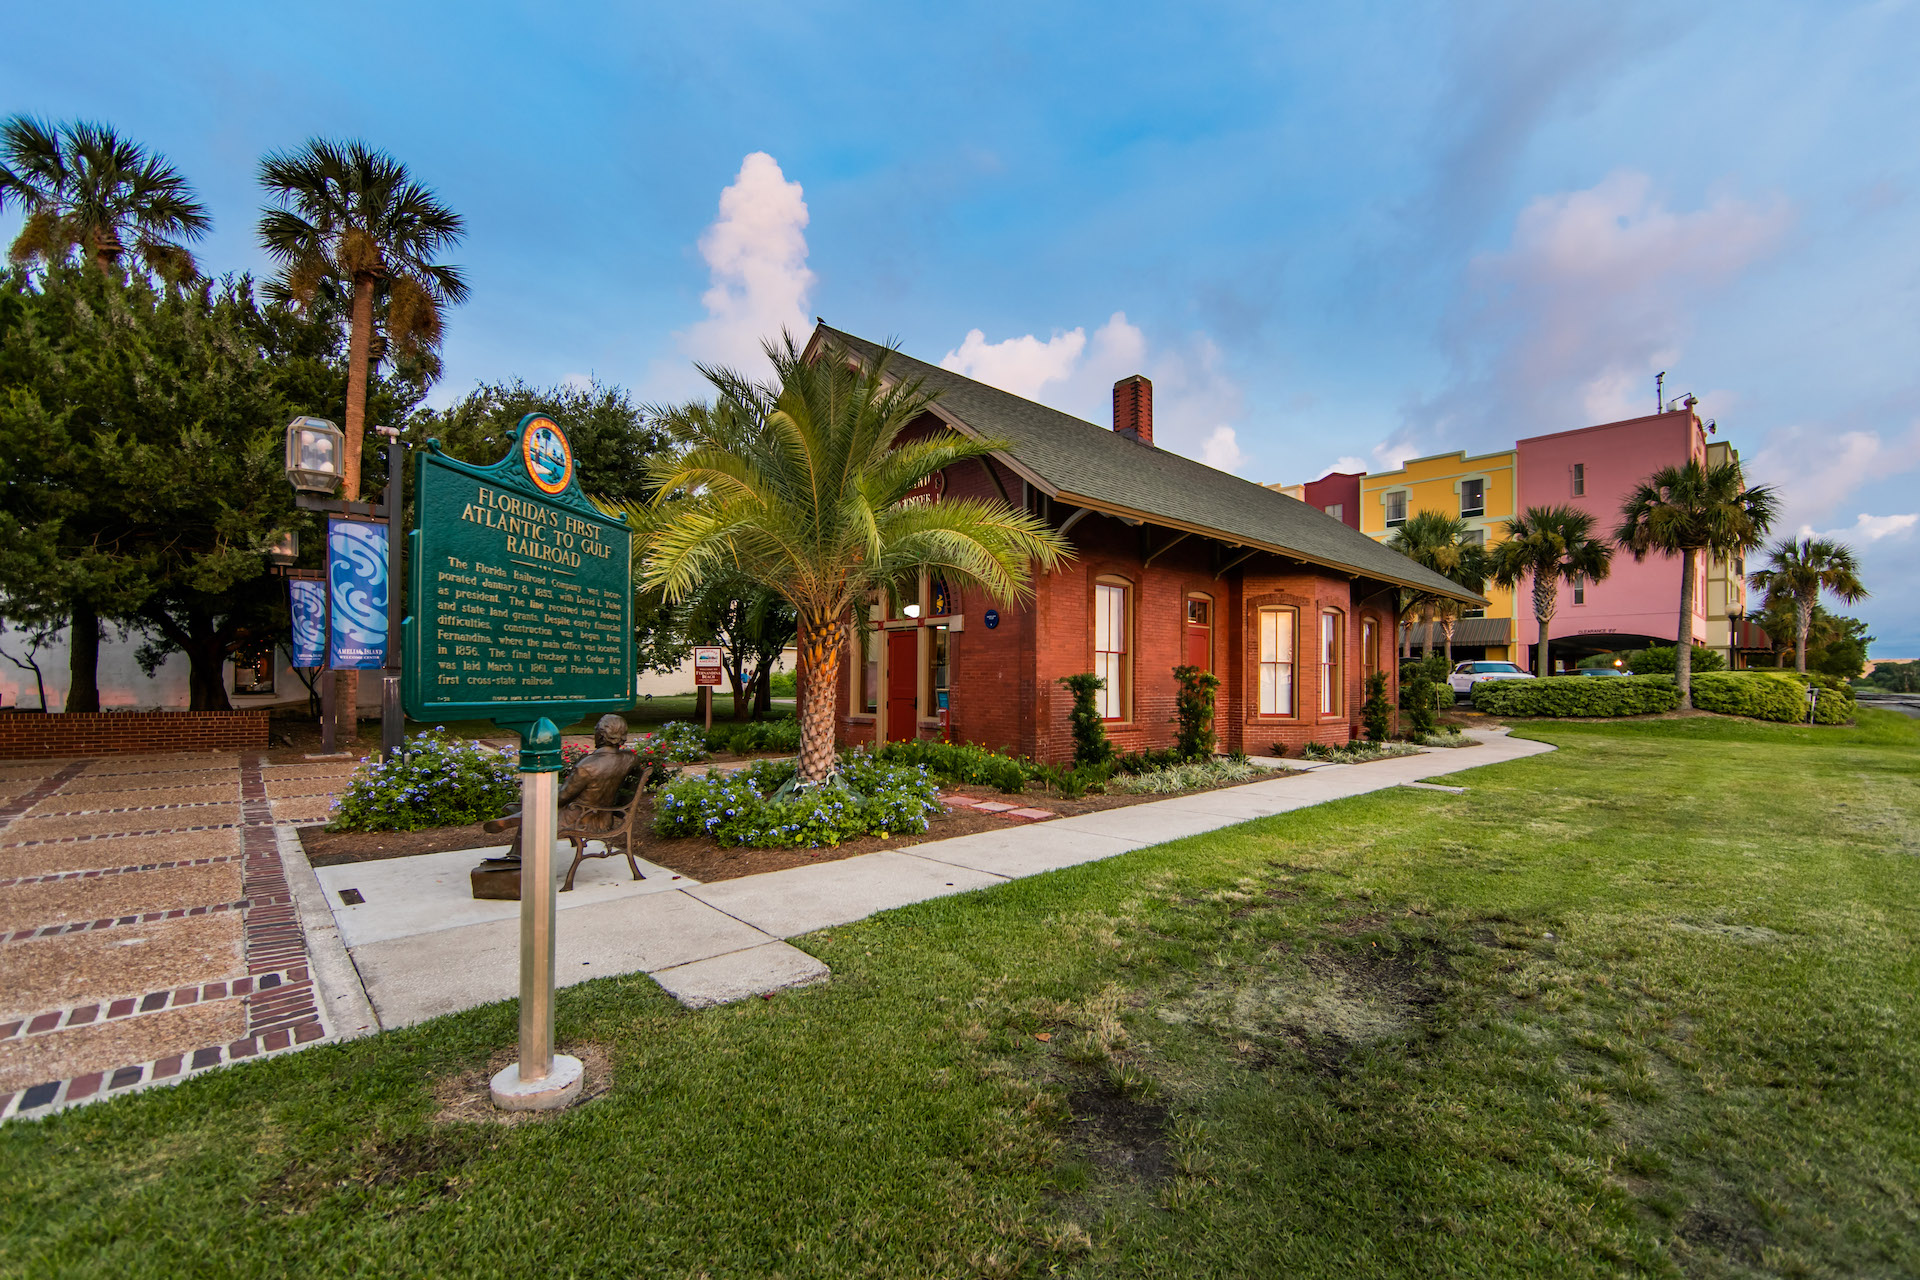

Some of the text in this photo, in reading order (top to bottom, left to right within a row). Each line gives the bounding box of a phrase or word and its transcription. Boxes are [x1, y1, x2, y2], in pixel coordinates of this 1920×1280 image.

[478, 487, 601, 540] FLORIDA'S FIRST
[462, 503, 611, 559] ATLANTIC TO GULF
[507, 535, 580, 568] RAILROAD
[439, 572, 477, 586] porated
[482, 578, 518, 593] January
[535, 588, 554, 599] 1853,
[560, 592, 574, 602] with
[577, 595, 595, 606] David
[448, 556, 468, 569] The
[476, 562, 507, 577] Florida
[514, 570, 546, 585] Railroad
[551, 579, 582, 593] Company
[604, 589, 621, 599] incor-
[438, 602, 456, 611] and
[462, 604, 485, 614] state
[490, 607, 508, 618] land
[544, 614, 570, 626] Despite
[573, 620, 591, 629] early
[595, 621, 620, 632] financial
[455, 590, 501, 603] president.
[509, 596, 525, 607] The
[530, 600, 544, 609] line
[549, 604, 578, 614] received
[582, 608, 597, 617] both
[600, 611, 621, 621] federal
[438, 614, 492, 630] difficulties,
[504, 624, 552, 635] construction
[607, 634, 620, 642] from
[438, 629, 493, 644] Fernandina,
[498, 636, 523, 646] where
[527, 639, 540, 647] the
[542, 640, 560, 649] main
[562, 641, 581, 650] office
[438, 644, 447, 654] in
[456, 645, 480, 656] 1856.
[489, 648, 506, 658] The
[512, 650, 530, 659] final
[537, 652, 568, 663] trackage
[586, 655, 604, 663] Cedar
[463, 661, 480, 670] laid
[488, 662, 513, 671] March
[571, 665, 594, 674] Florida
[438, 674, 554, 685] first cross-state railroad.
